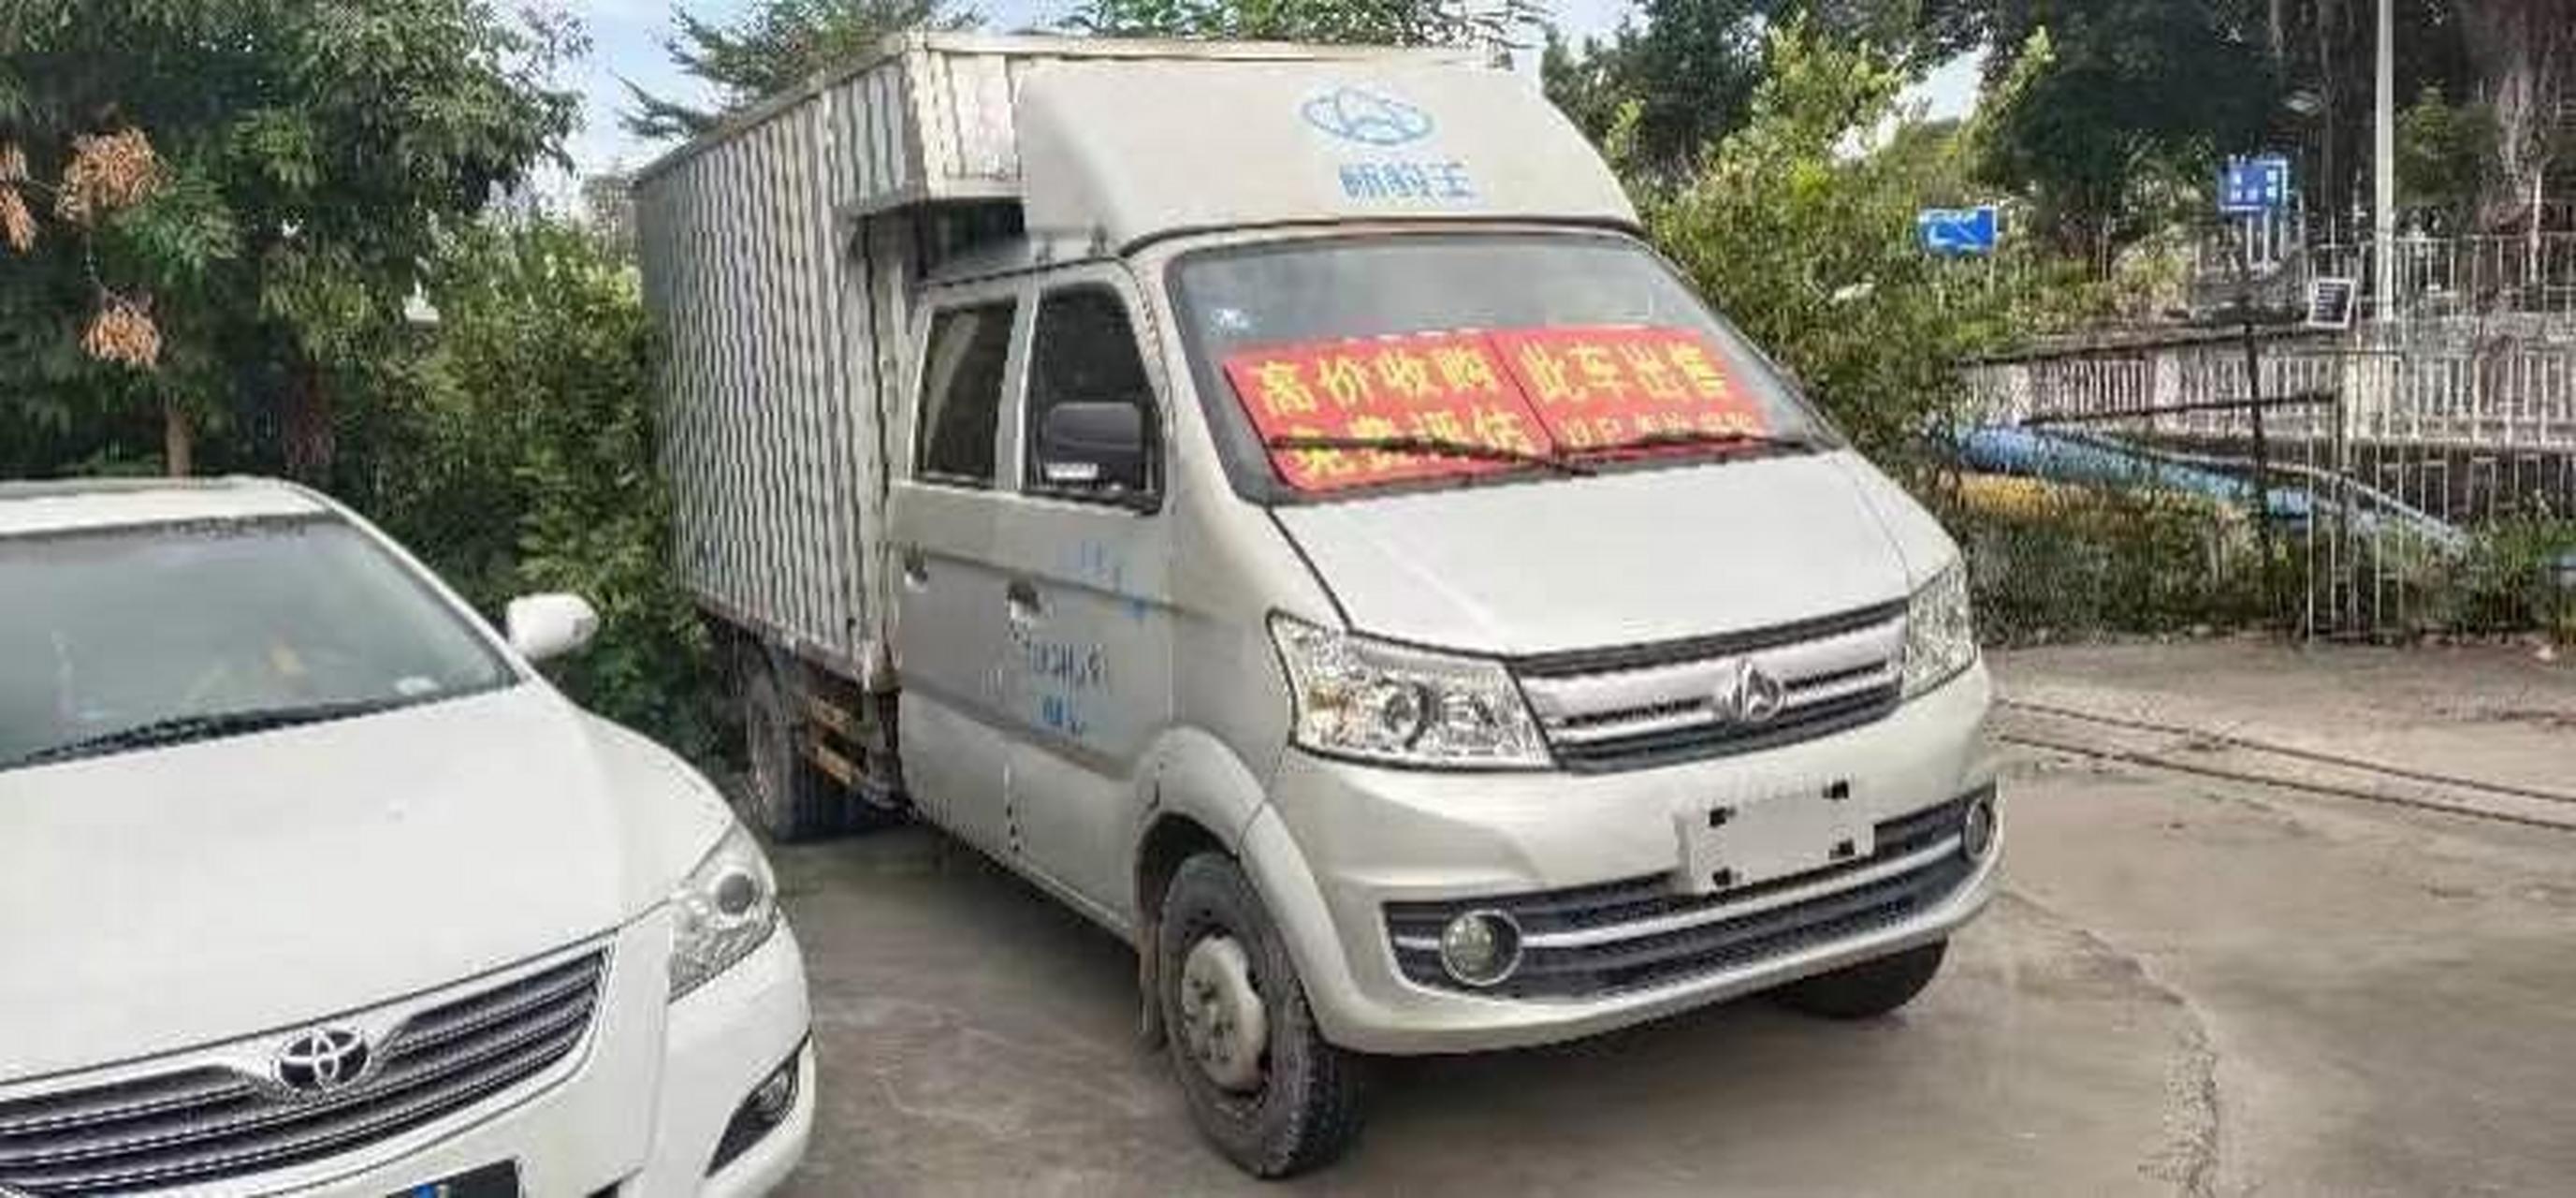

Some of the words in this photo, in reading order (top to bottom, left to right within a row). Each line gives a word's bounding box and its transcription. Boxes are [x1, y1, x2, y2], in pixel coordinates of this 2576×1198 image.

[1259, 344, 1497, 417] 高价收购
[1519, 338, 1730, 403] 此车出售
